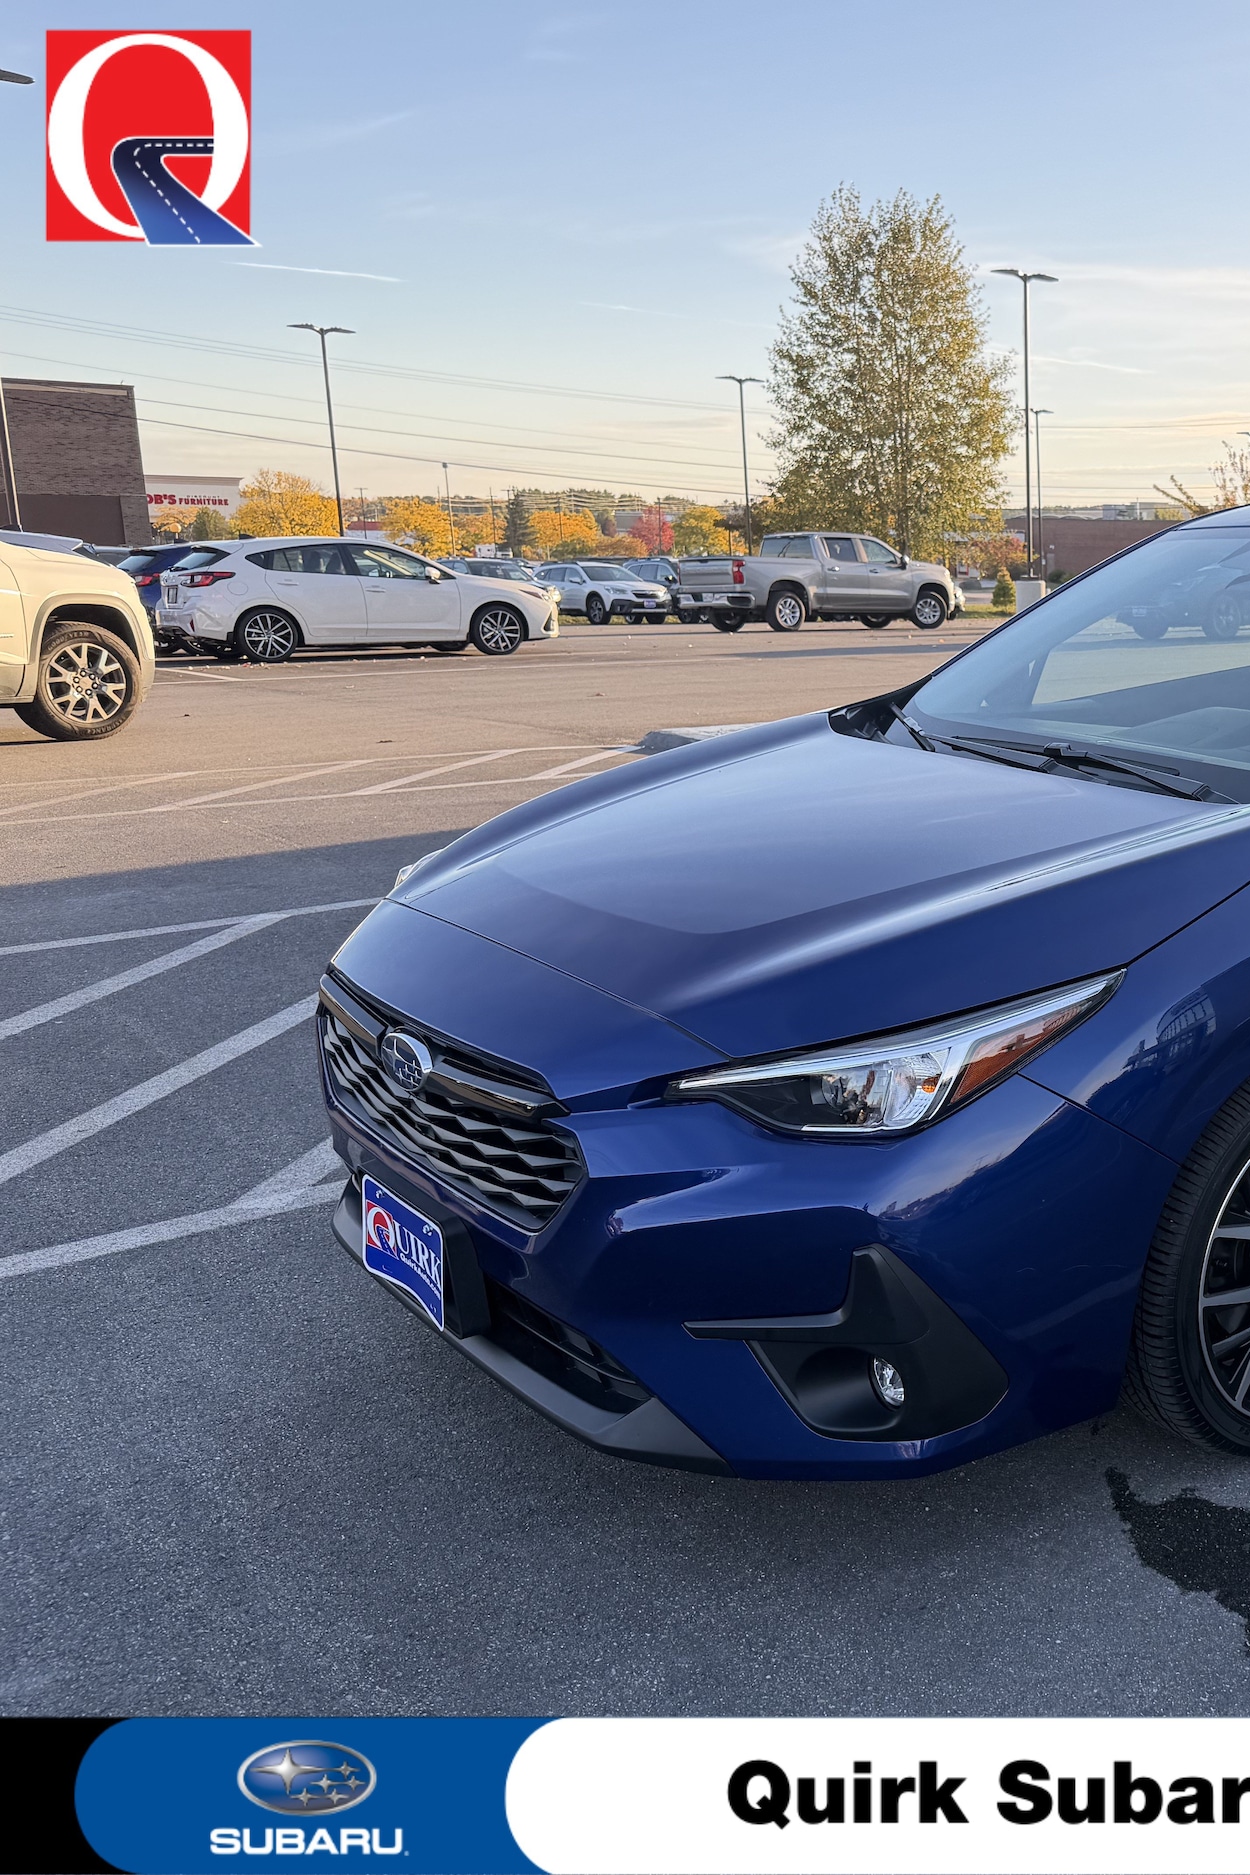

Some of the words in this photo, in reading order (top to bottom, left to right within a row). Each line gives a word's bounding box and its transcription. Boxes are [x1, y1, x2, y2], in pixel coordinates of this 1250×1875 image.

[146, 493, 177, 505] OB'S
[178, 497, 230, 506] FURNITURE
[366, 1206, 442, 1292] QUIRK
